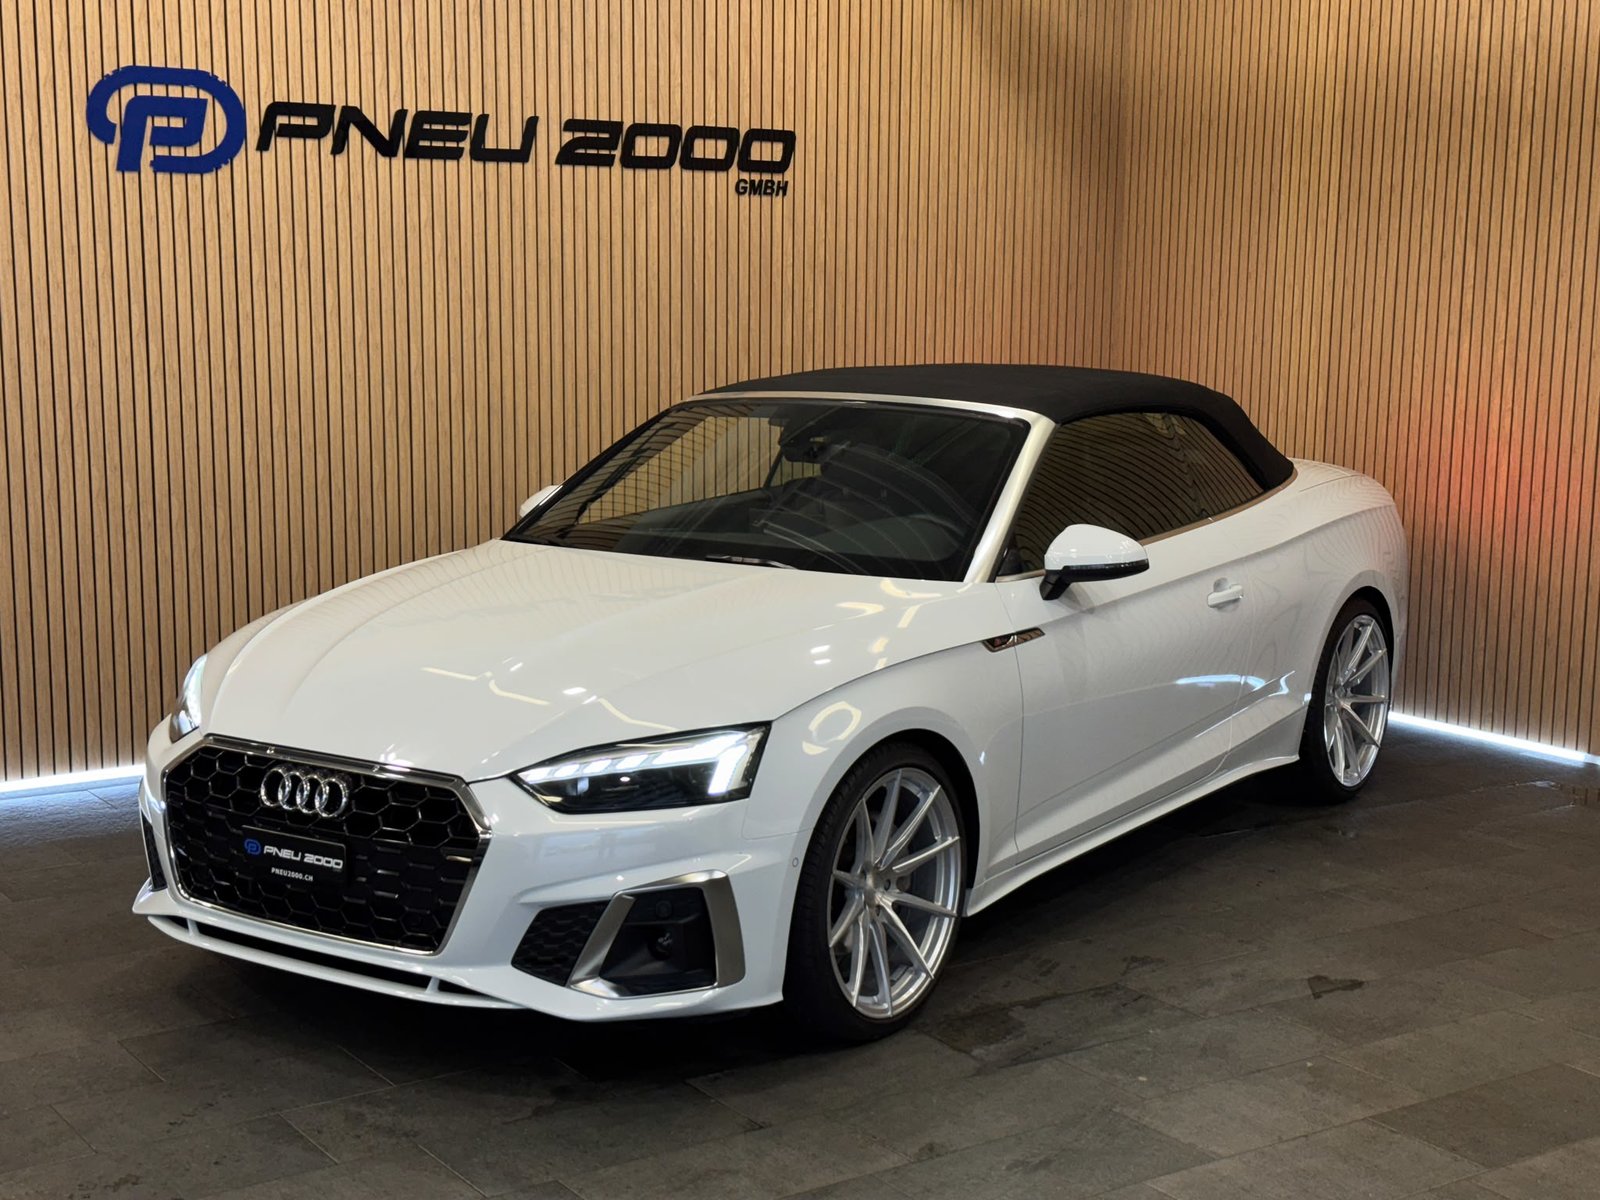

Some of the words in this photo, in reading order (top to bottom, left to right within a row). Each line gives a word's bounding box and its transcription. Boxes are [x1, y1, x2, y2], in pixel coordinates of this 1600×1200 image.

[256, 101, 539, 163] PNEU
[555, 118, 796, 173] 2000
[735, 179, 788, 197] GMBH
[263, 845, 302, 861] PNEU
[303, 853, 344, 869] 2000
[271, 867, 314, 882] PNEU2000.CH
